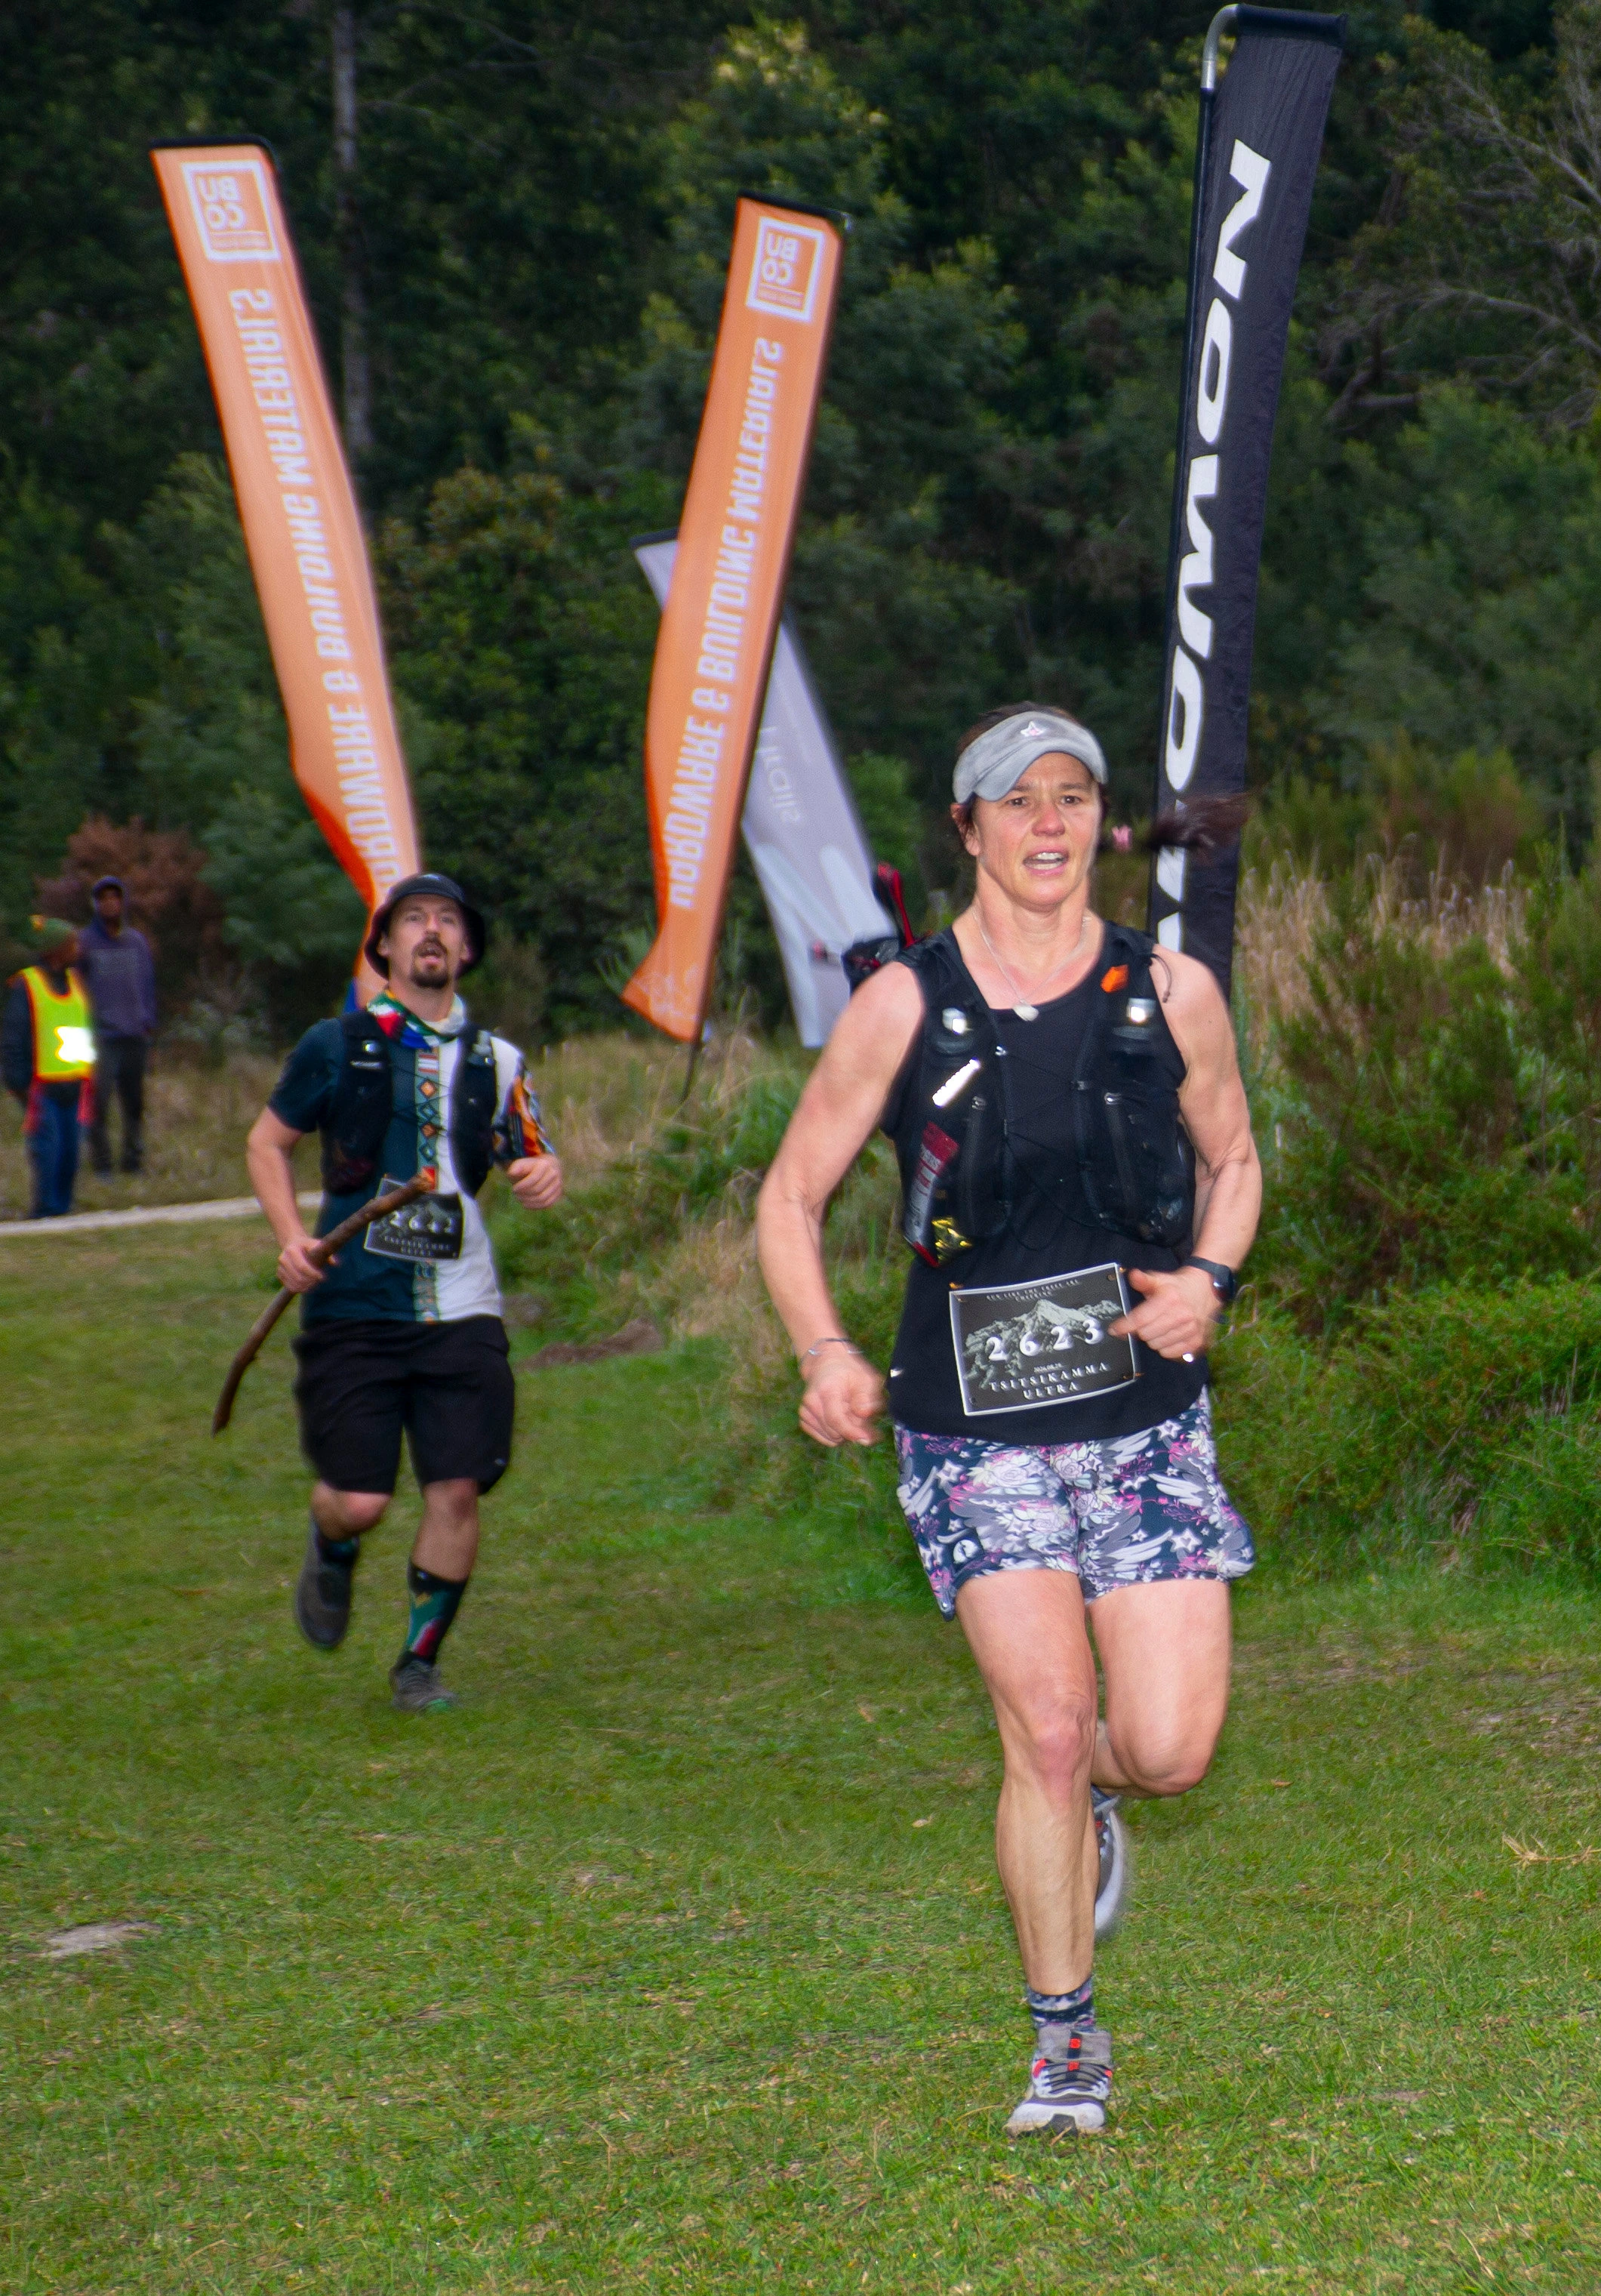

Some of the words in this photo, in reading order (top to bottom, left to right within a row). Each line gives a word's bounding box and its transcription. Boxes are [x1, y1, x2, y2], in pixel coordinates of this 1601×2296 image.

[986, 1319, 1104, 1362] 2623
[990, 1362, 1110, 1393] TSITSIKAMMA
[1023, 1382, 1081, 1400] ULTRA
